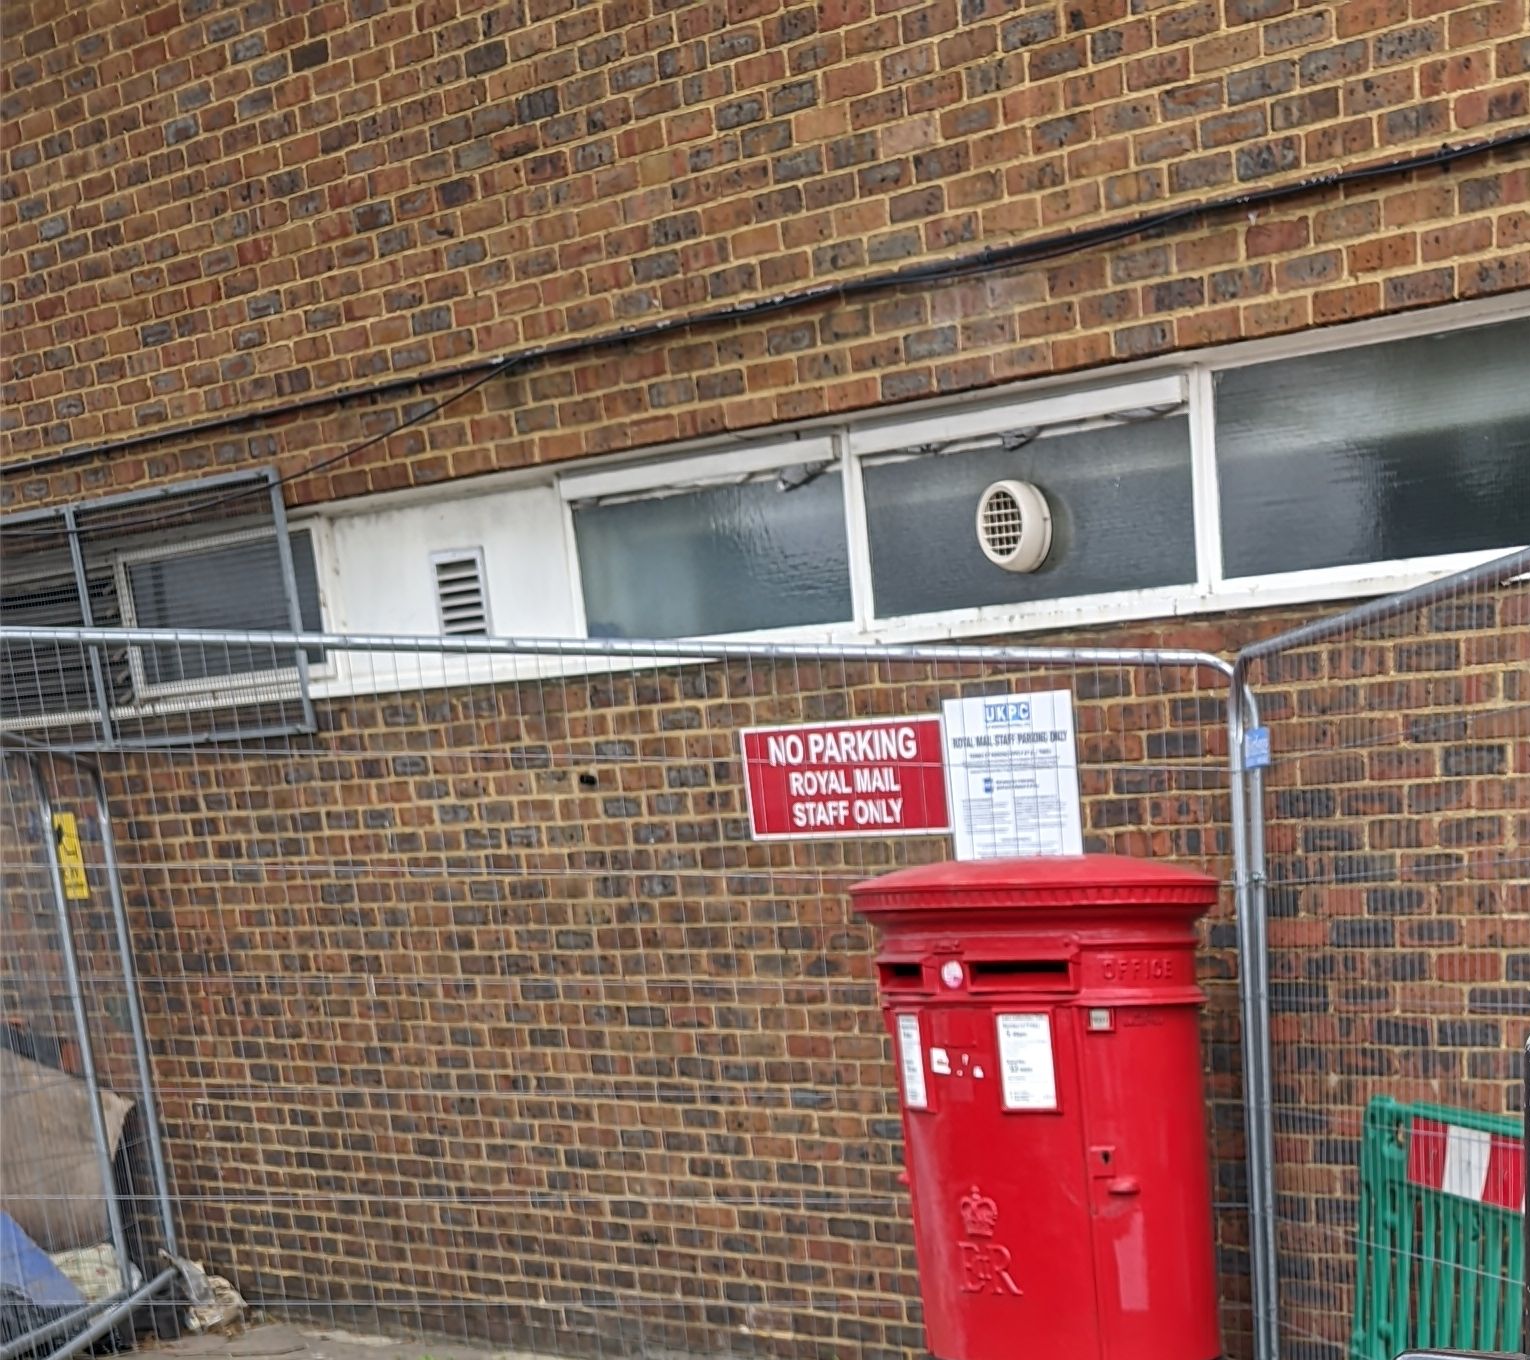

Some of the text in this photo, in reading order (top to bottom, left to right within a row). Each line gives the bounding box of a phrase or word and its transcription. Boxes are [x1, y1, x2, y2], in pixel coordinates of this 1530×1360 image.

[985, 703, 1029, 721] UKPC
[767, 727, 918, 767] NO PARKING
[952, 730, 1068, 749] ROYAL MAIL STAFF PARKING ONLY
[789, 767, 901, 797] ROYAL MAIL
[792, 797, 904, 827] STAFF ONLY
[1103, 959, 1173, 980] OFFICE
